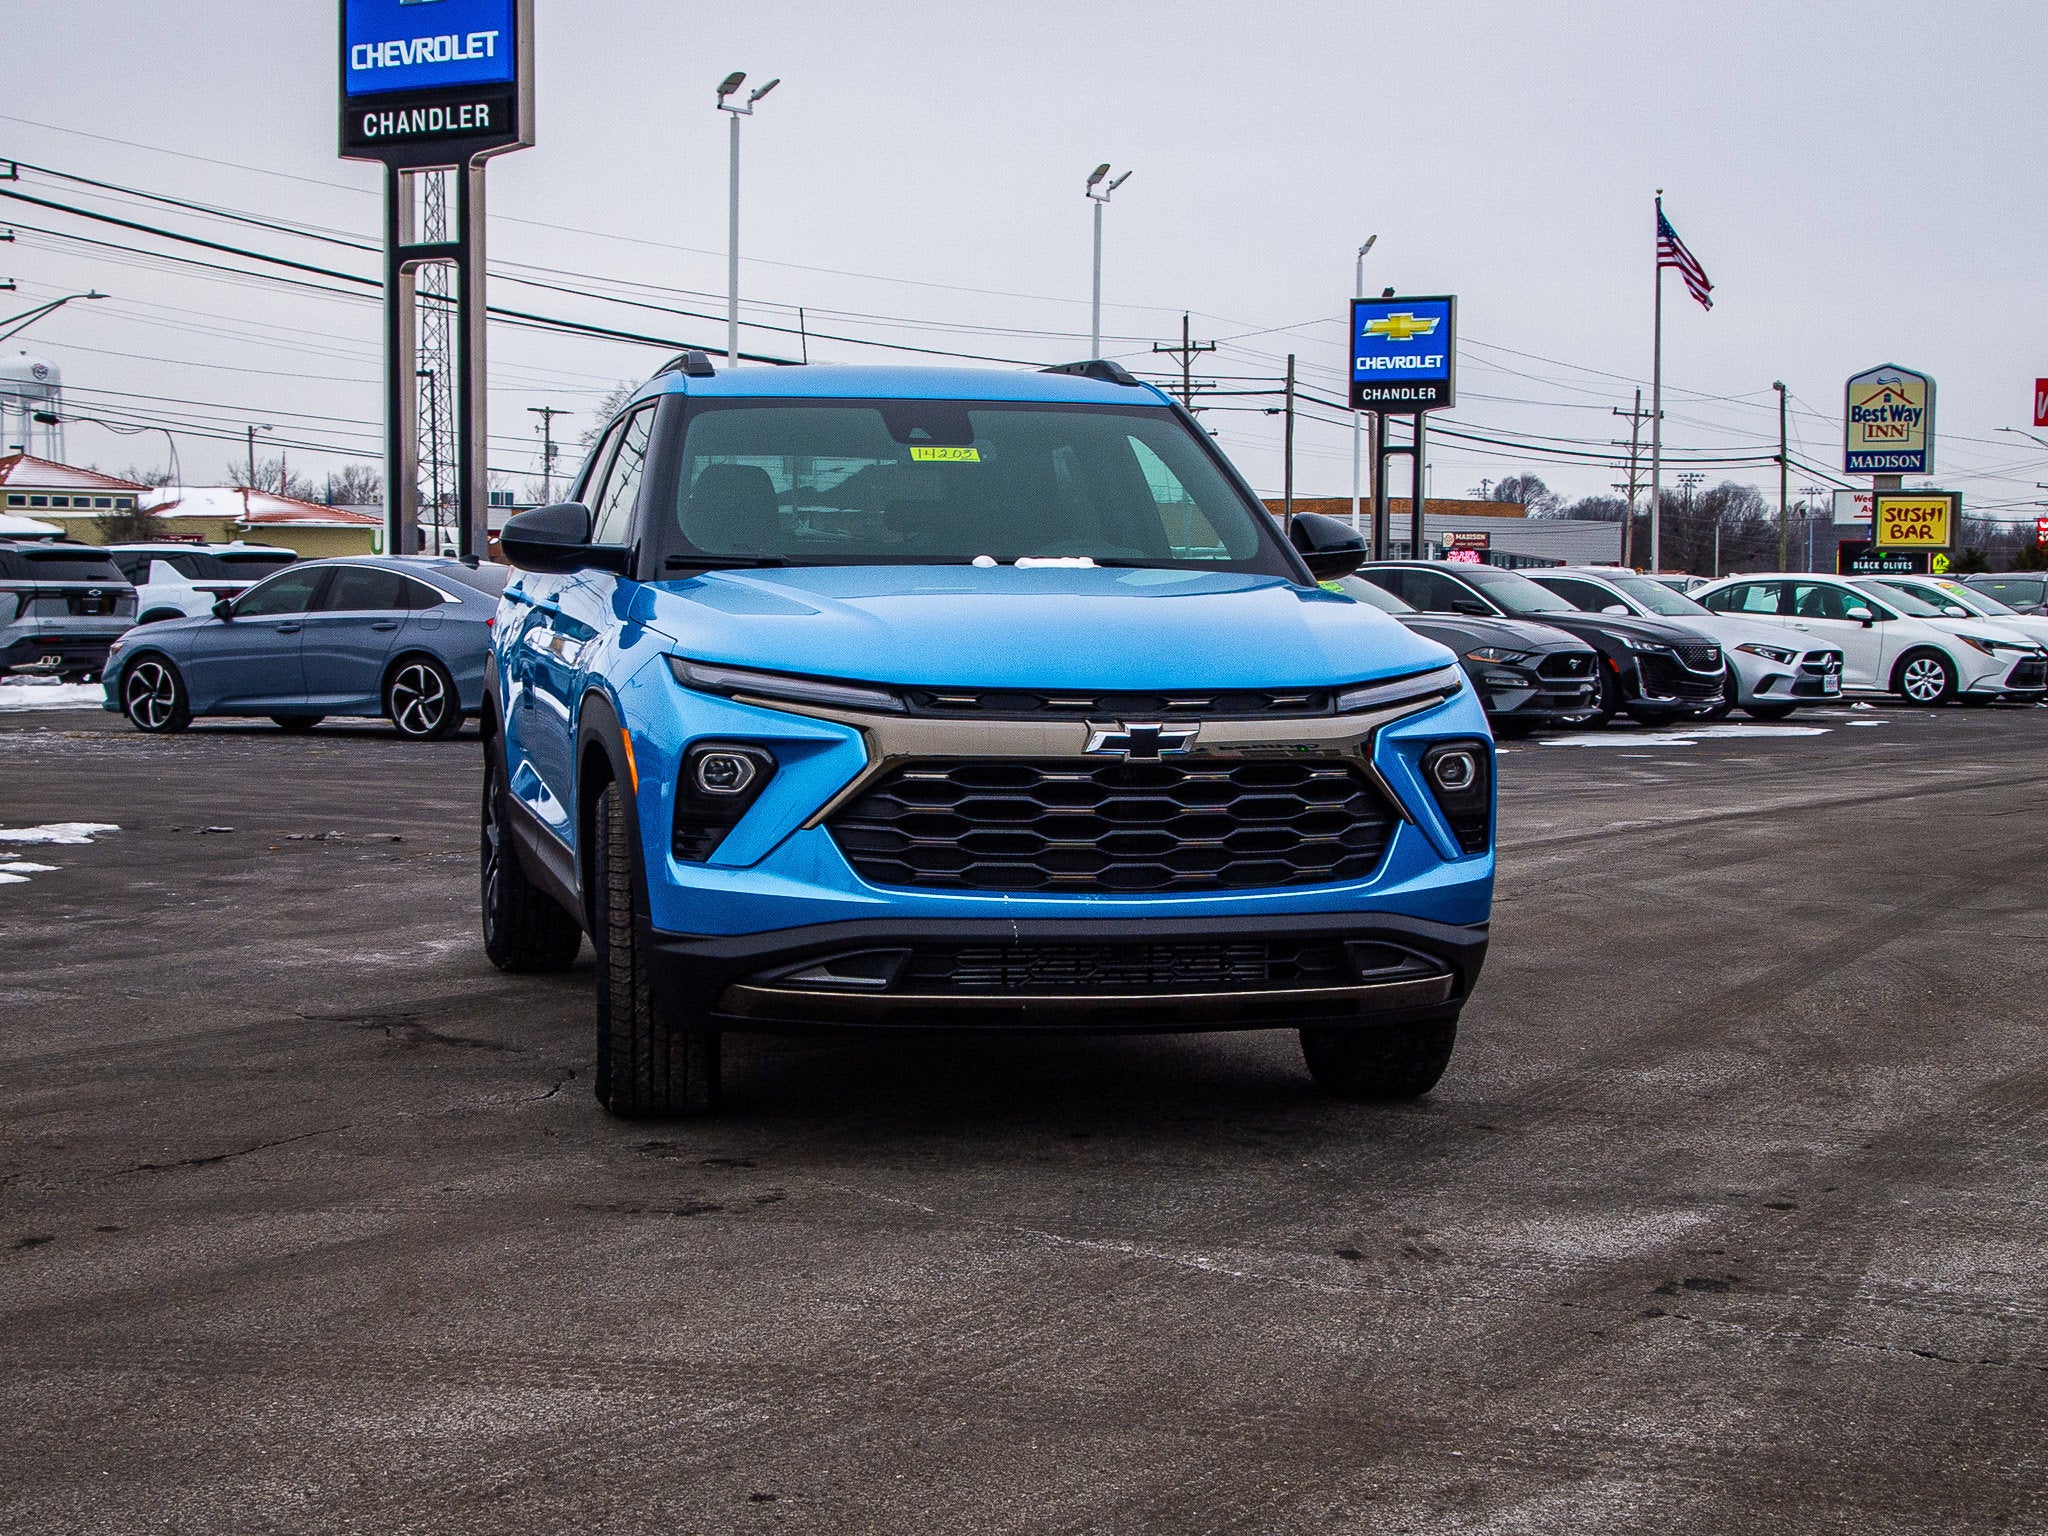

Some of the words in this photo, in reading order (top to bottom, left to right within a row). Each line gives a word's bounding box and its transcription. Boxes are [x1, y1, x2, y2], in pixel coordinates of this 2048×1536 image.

[351, 30, 499, 71] CHEVROLET
[363, 104, 490, 137] CHANDLER
[1356, 354, 1444, 370] CHEVROLET
[1362, 387, 1437, 401] CHANDLER
[1851, 405, 1888, 423] Best
[1888, 404, 1923, 428] Way
[1866, 424, 1905, 438] INN
[917, 448, 973, 460] 14203
[1850, 455, 1921, 468] MADISON
[1884, 507, 1943, 523] SUSHI
[1890, 524, 1935, 539] BAR
[1853, 561, 1879, 570] BLACK
[1883, 561, 1913, 570] OLIVES
